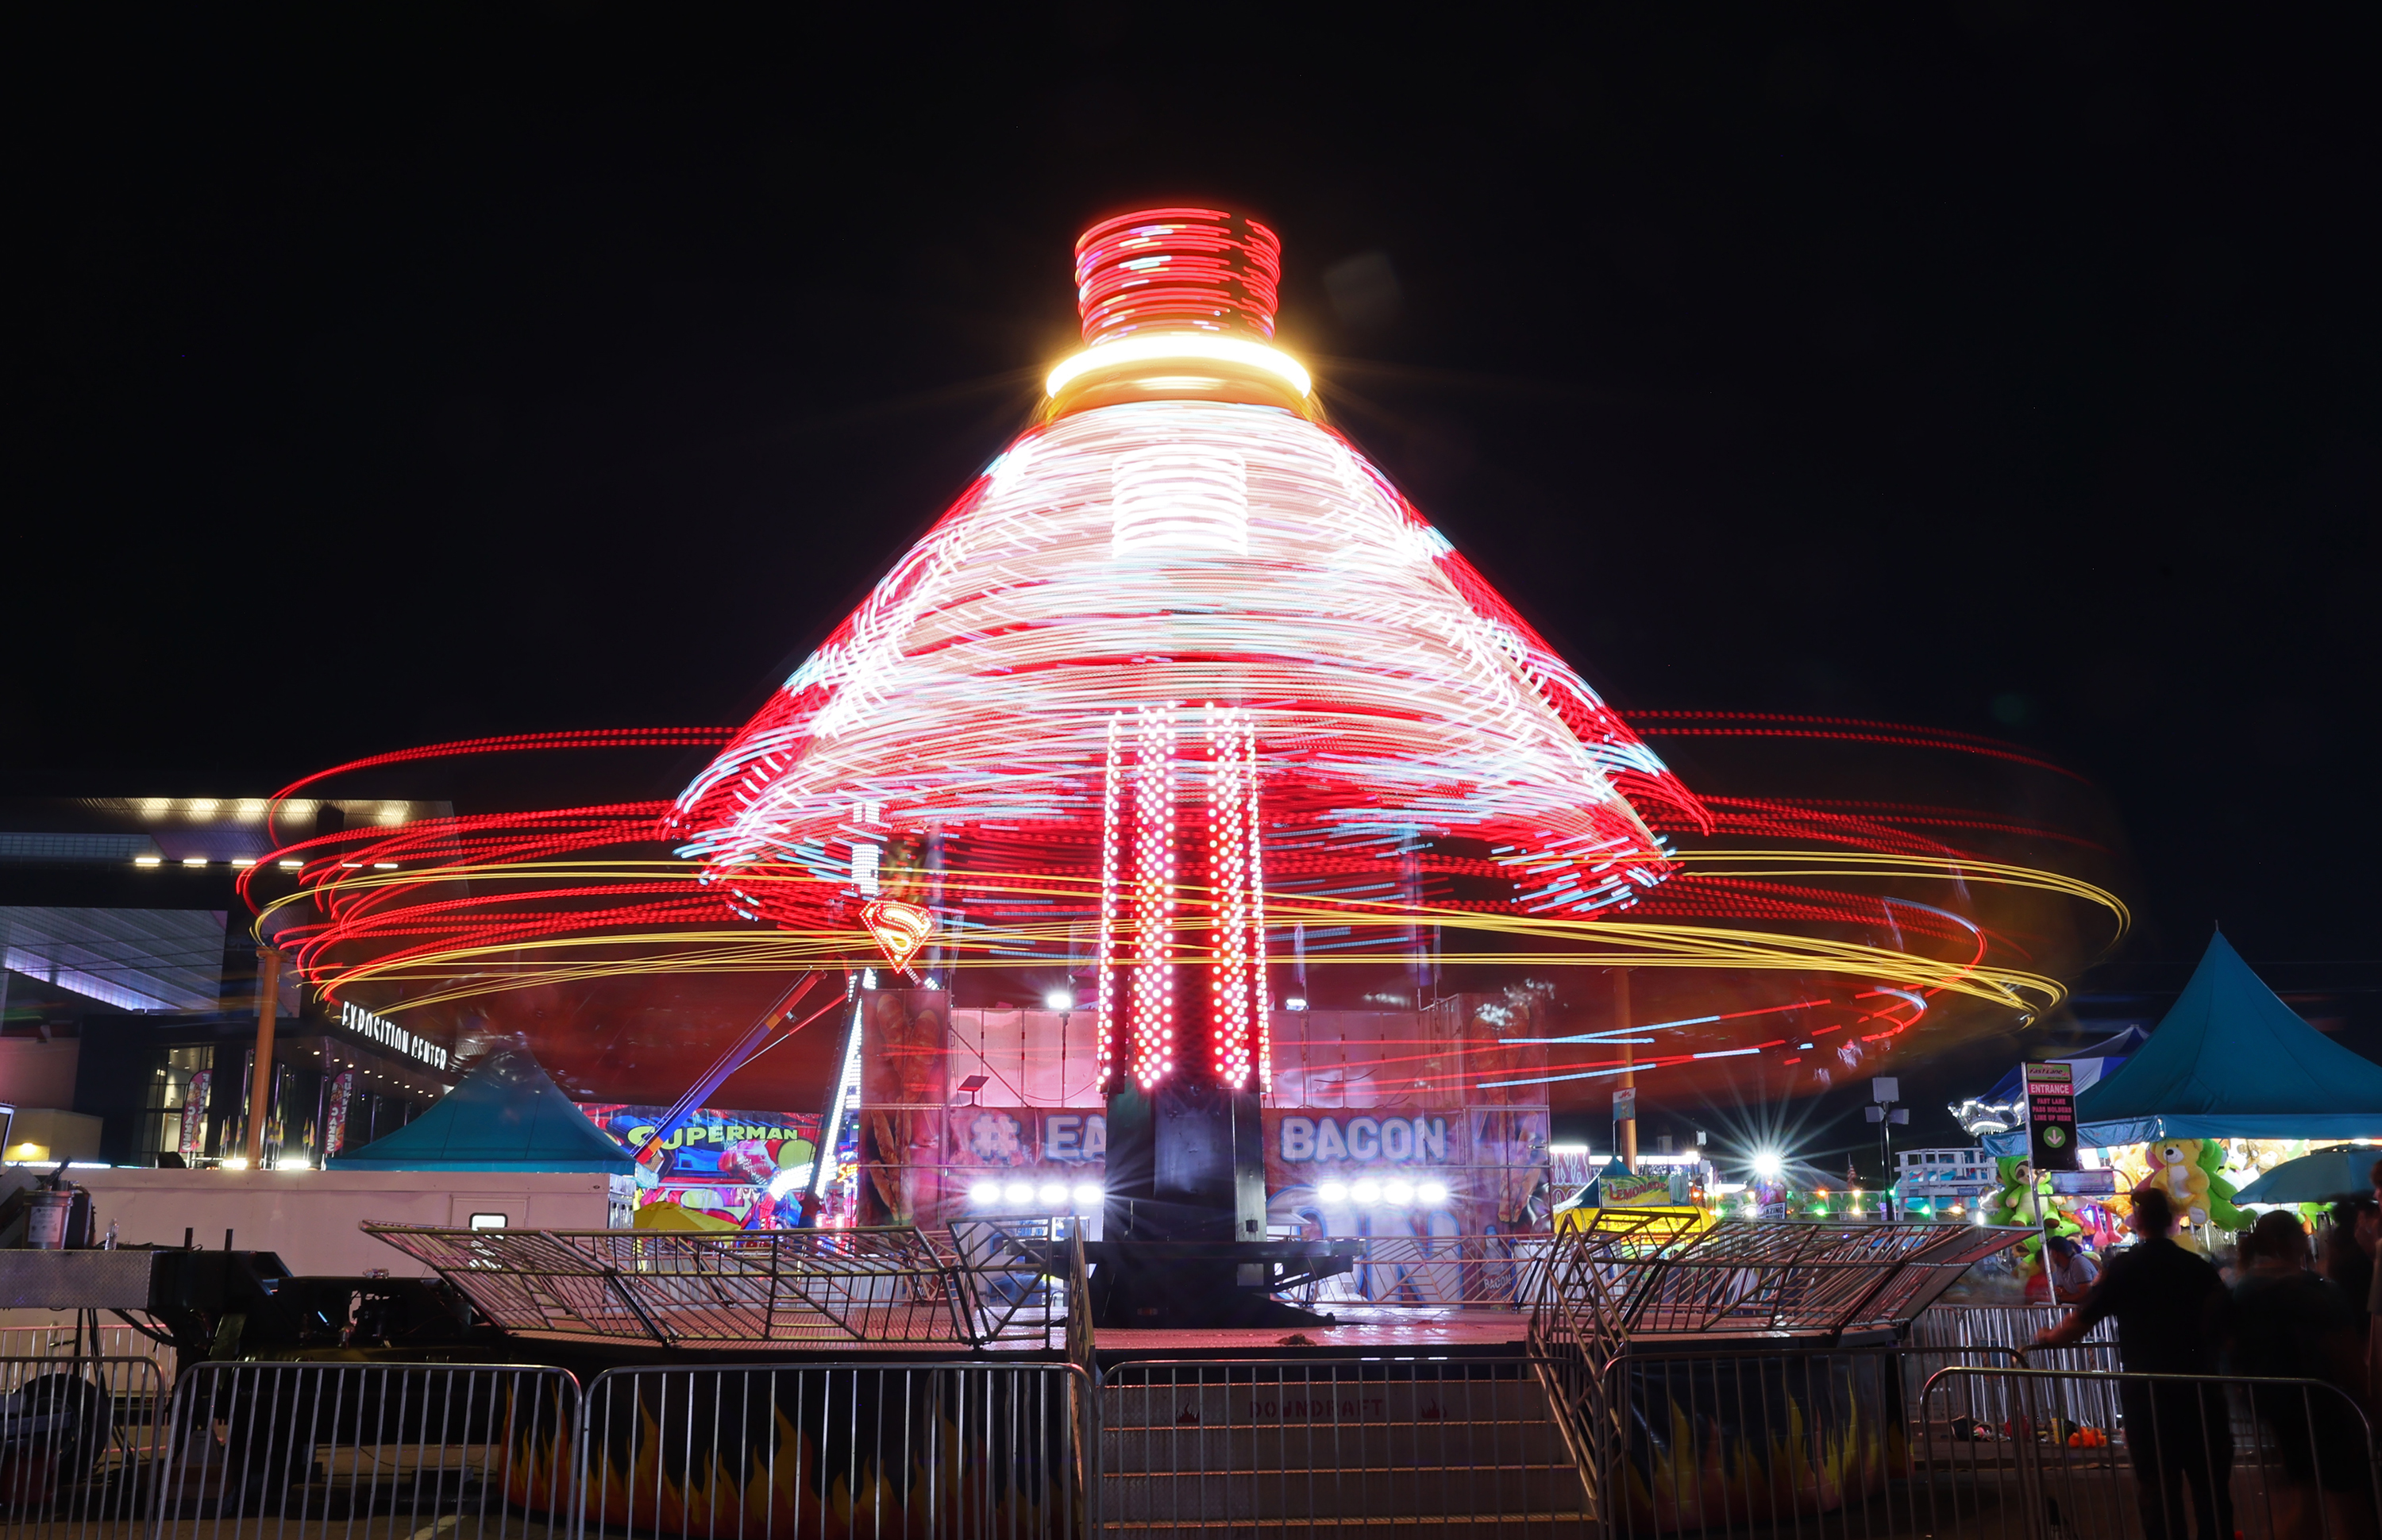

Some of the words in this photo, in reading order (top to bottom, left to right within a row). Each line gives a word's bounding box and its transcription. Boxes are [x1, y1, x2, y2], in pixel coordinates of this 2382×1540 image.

[342, 1001, 409, 1054] EXPOSITION
[411, 1035, 447, 1070] CENTER
[2031, 1084, 2069, 1094] ENTRANCE
[627, 1126, 798, 1151] SUPERMAN
[1282, 1116, 1447, 1162] BACON
[1551, 1152, 1589, 1186] NA
[1608, 1180, 1667, 1200] LEMONADE
[1484, 1274, 1512, 1289] BACON
[1249, 1399, 1383, 1418] DOWNDRAFT
